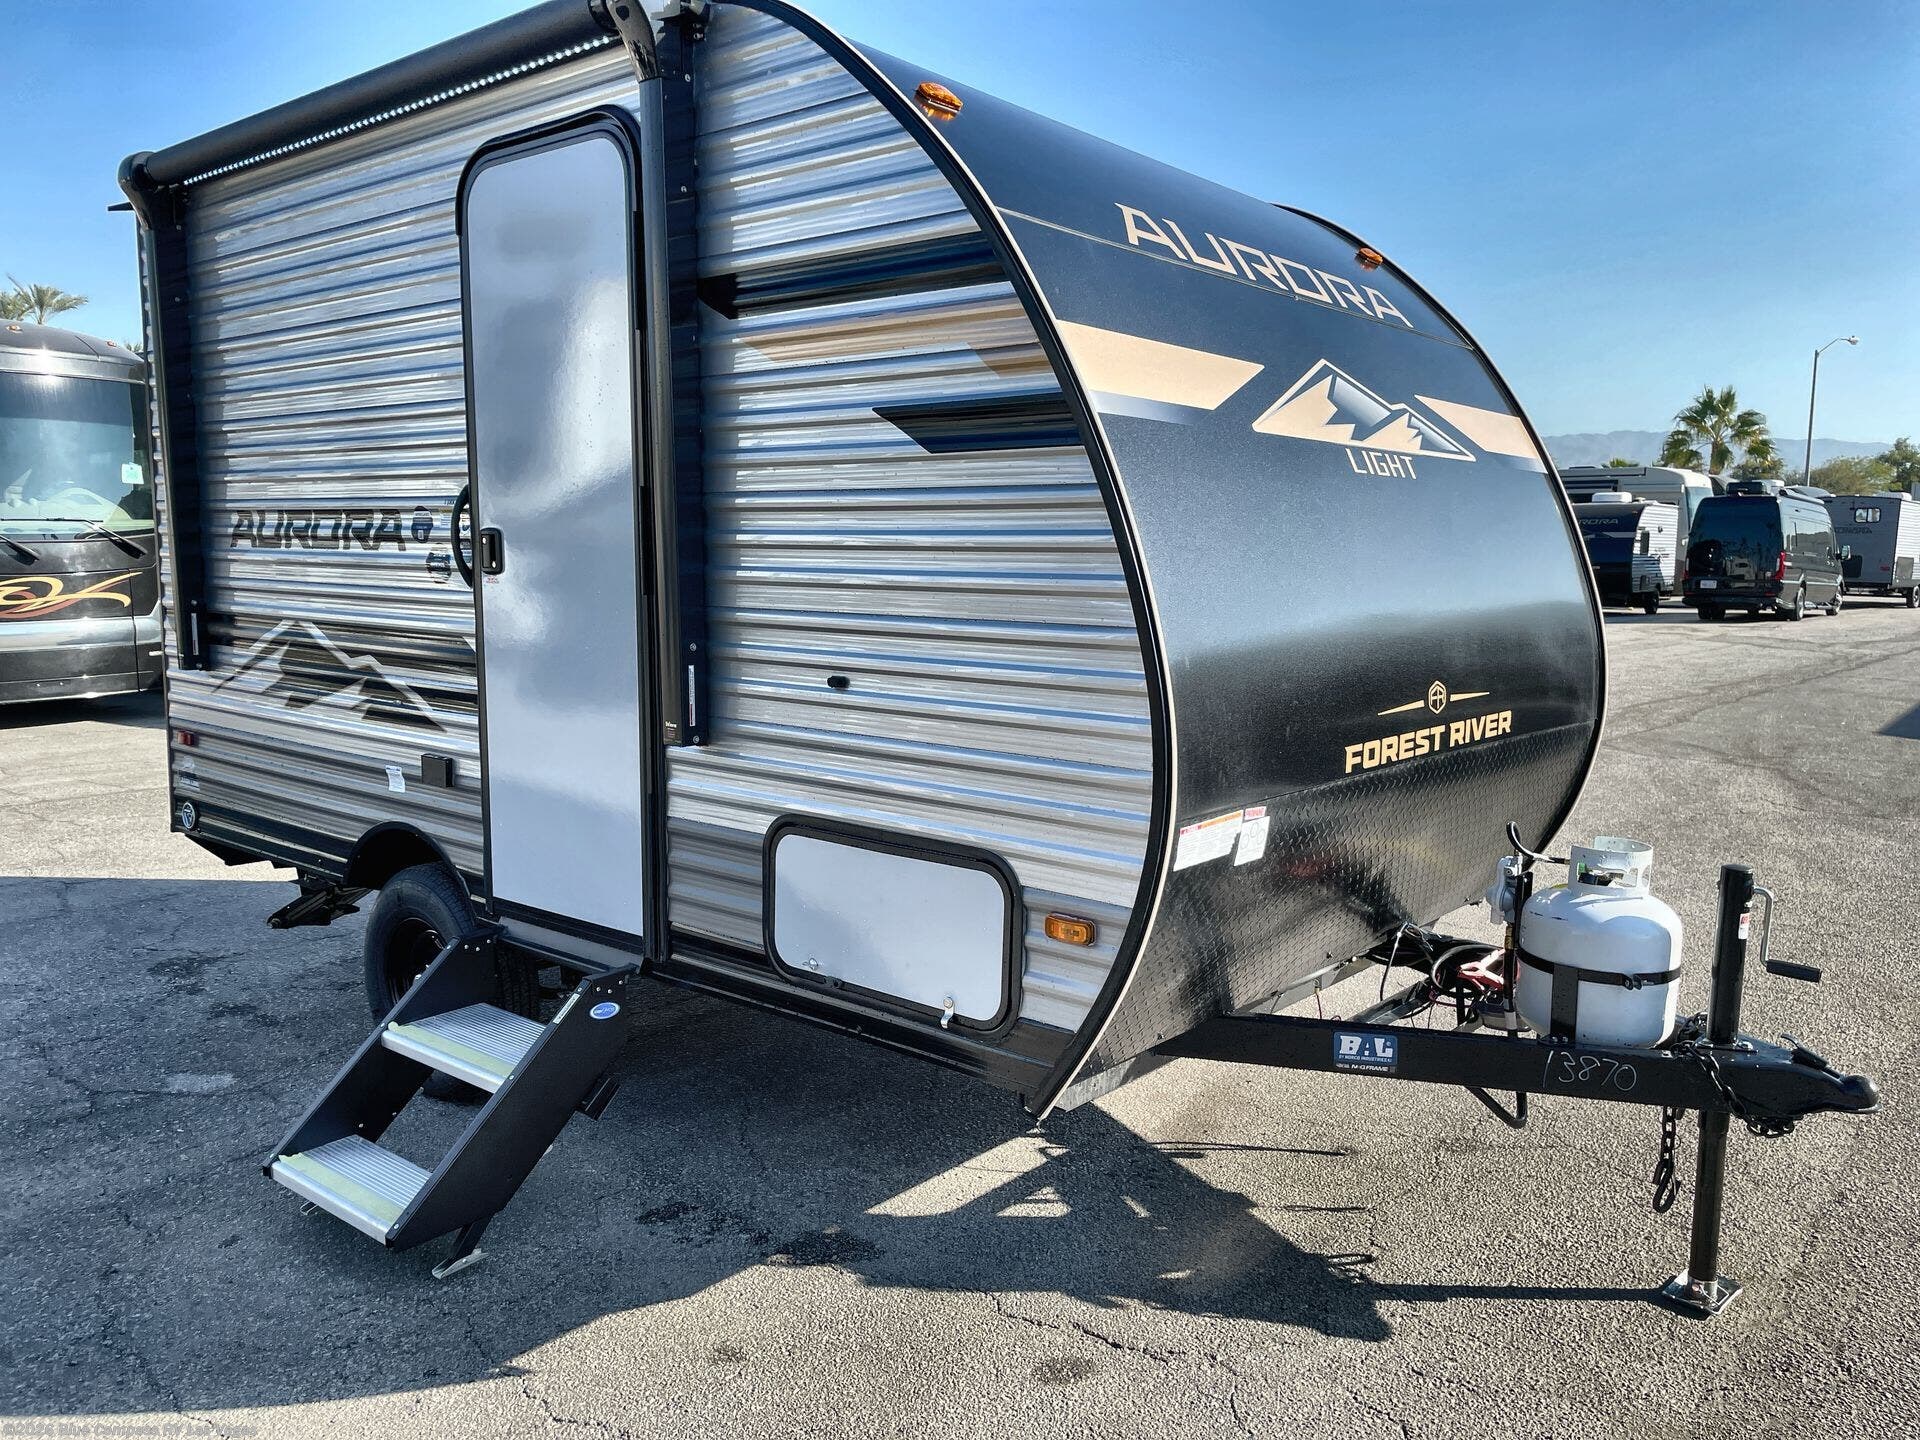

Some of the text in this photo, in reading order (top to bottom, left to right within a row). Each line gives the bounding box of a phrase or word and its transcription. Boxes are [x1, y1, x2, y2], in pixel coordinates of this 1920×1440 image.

[1114, 201, 1414, 328] AURORA
[1344, 447, 1417, 480] LIGHT
[230, 509, 406, 552] AURORA
[1344, 710, 1512, 774] FOREST RIVER
[1542, 1050, 1637, 1091] 13870
